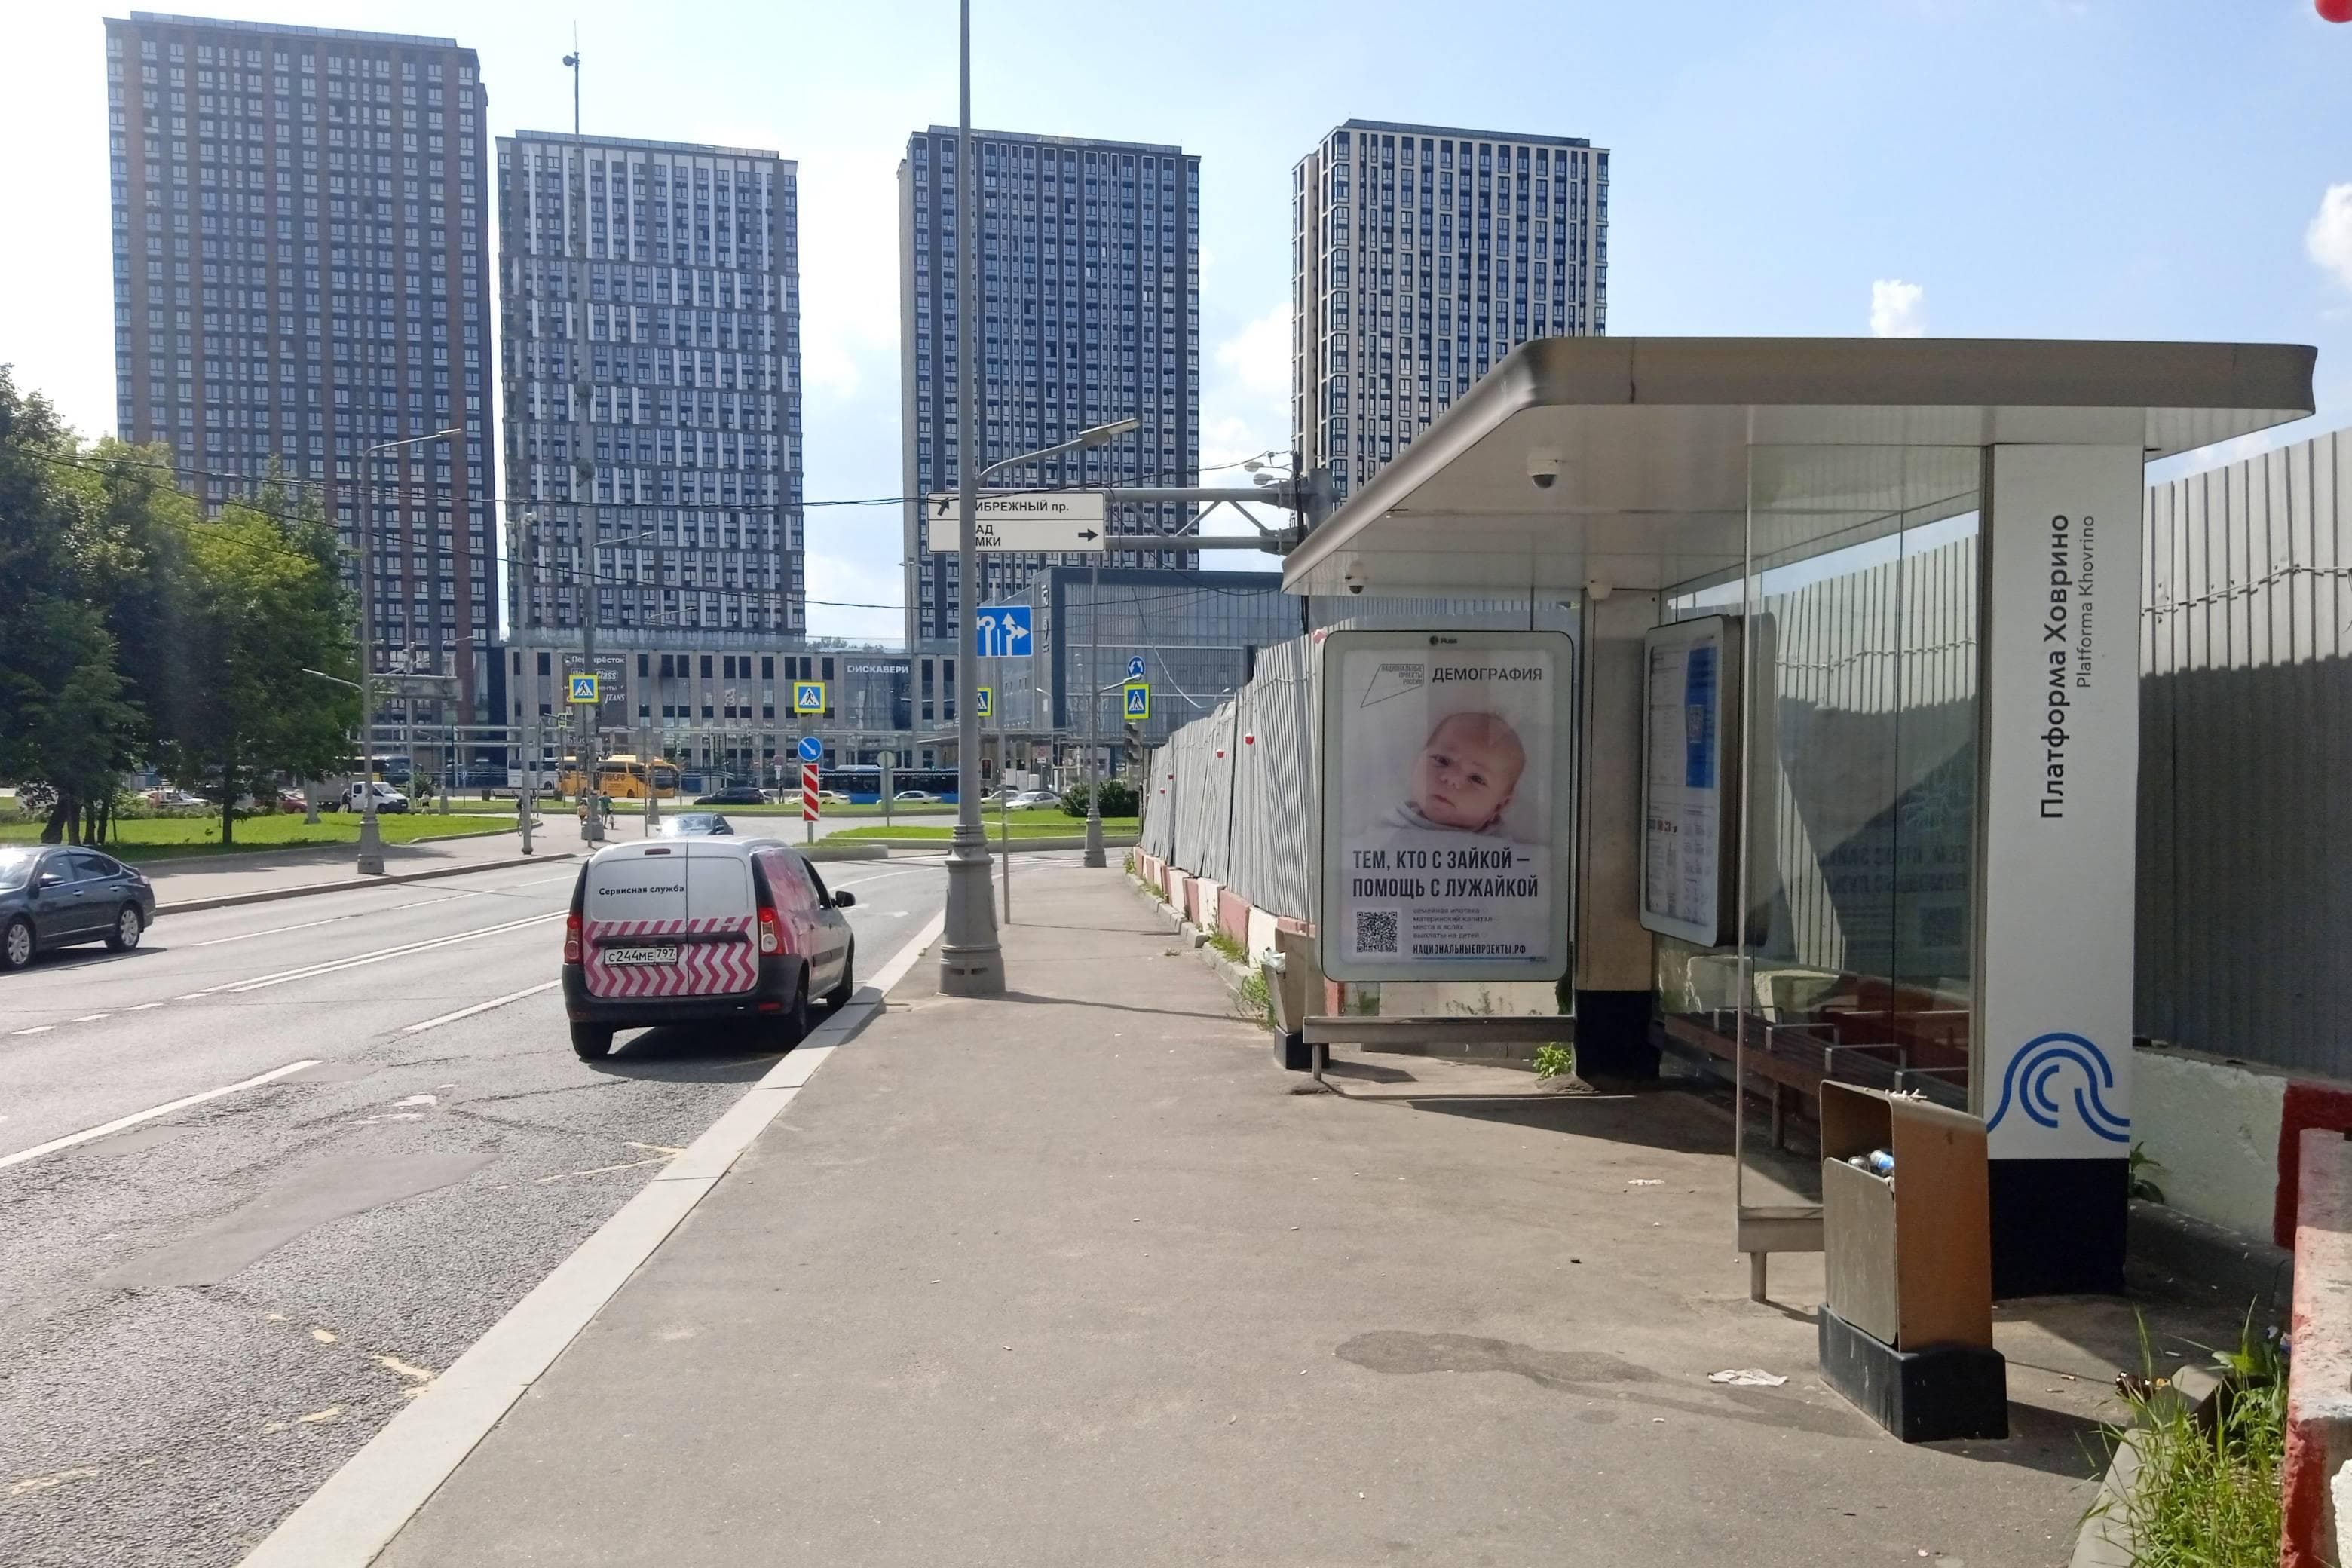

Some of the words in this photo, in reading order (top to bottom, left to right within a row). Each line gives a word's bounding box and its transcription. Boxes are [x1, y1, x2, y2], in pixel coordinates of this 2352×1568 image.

[975, 499, 1048, 511] ИБРЕЖНЫЙ
[1052, 504, 1069, 513] пр.
[975, 525, 994, 536] АД
[975, 537, 1001, 547] МКИ
[2078, 516, 2094, 596] Khovrino
[2044, 514, 2072, 643] Ховрино
[2076, 603, 2093, 688] Platforma
[1432, 668, 1542, 683] ДЕМОГРАФИЯ
[2041, 650, 2070, 819] Платформа
[1353, 850, 1391, 871] ТЕМ,
[1396, 850, 1427, 869] КТО
[1432, 850, 1441, 869] С
[1447, 847, 1511, 869] ЗАЙКОЙ
[599, 887, 648, 896] Сервисная
[650, 884, 684, 894] служба
[1352, 878, 1425, 899] ПОМОЩЬ
[1430, 878, 1440, 897] С
[1444, 874, 1538, 897] ЛУЖАЙКОЙ
[1413, 944, 1526, 955] НАЦИОНАЛЬНЫЕПРОЕКТЫ.РФ
